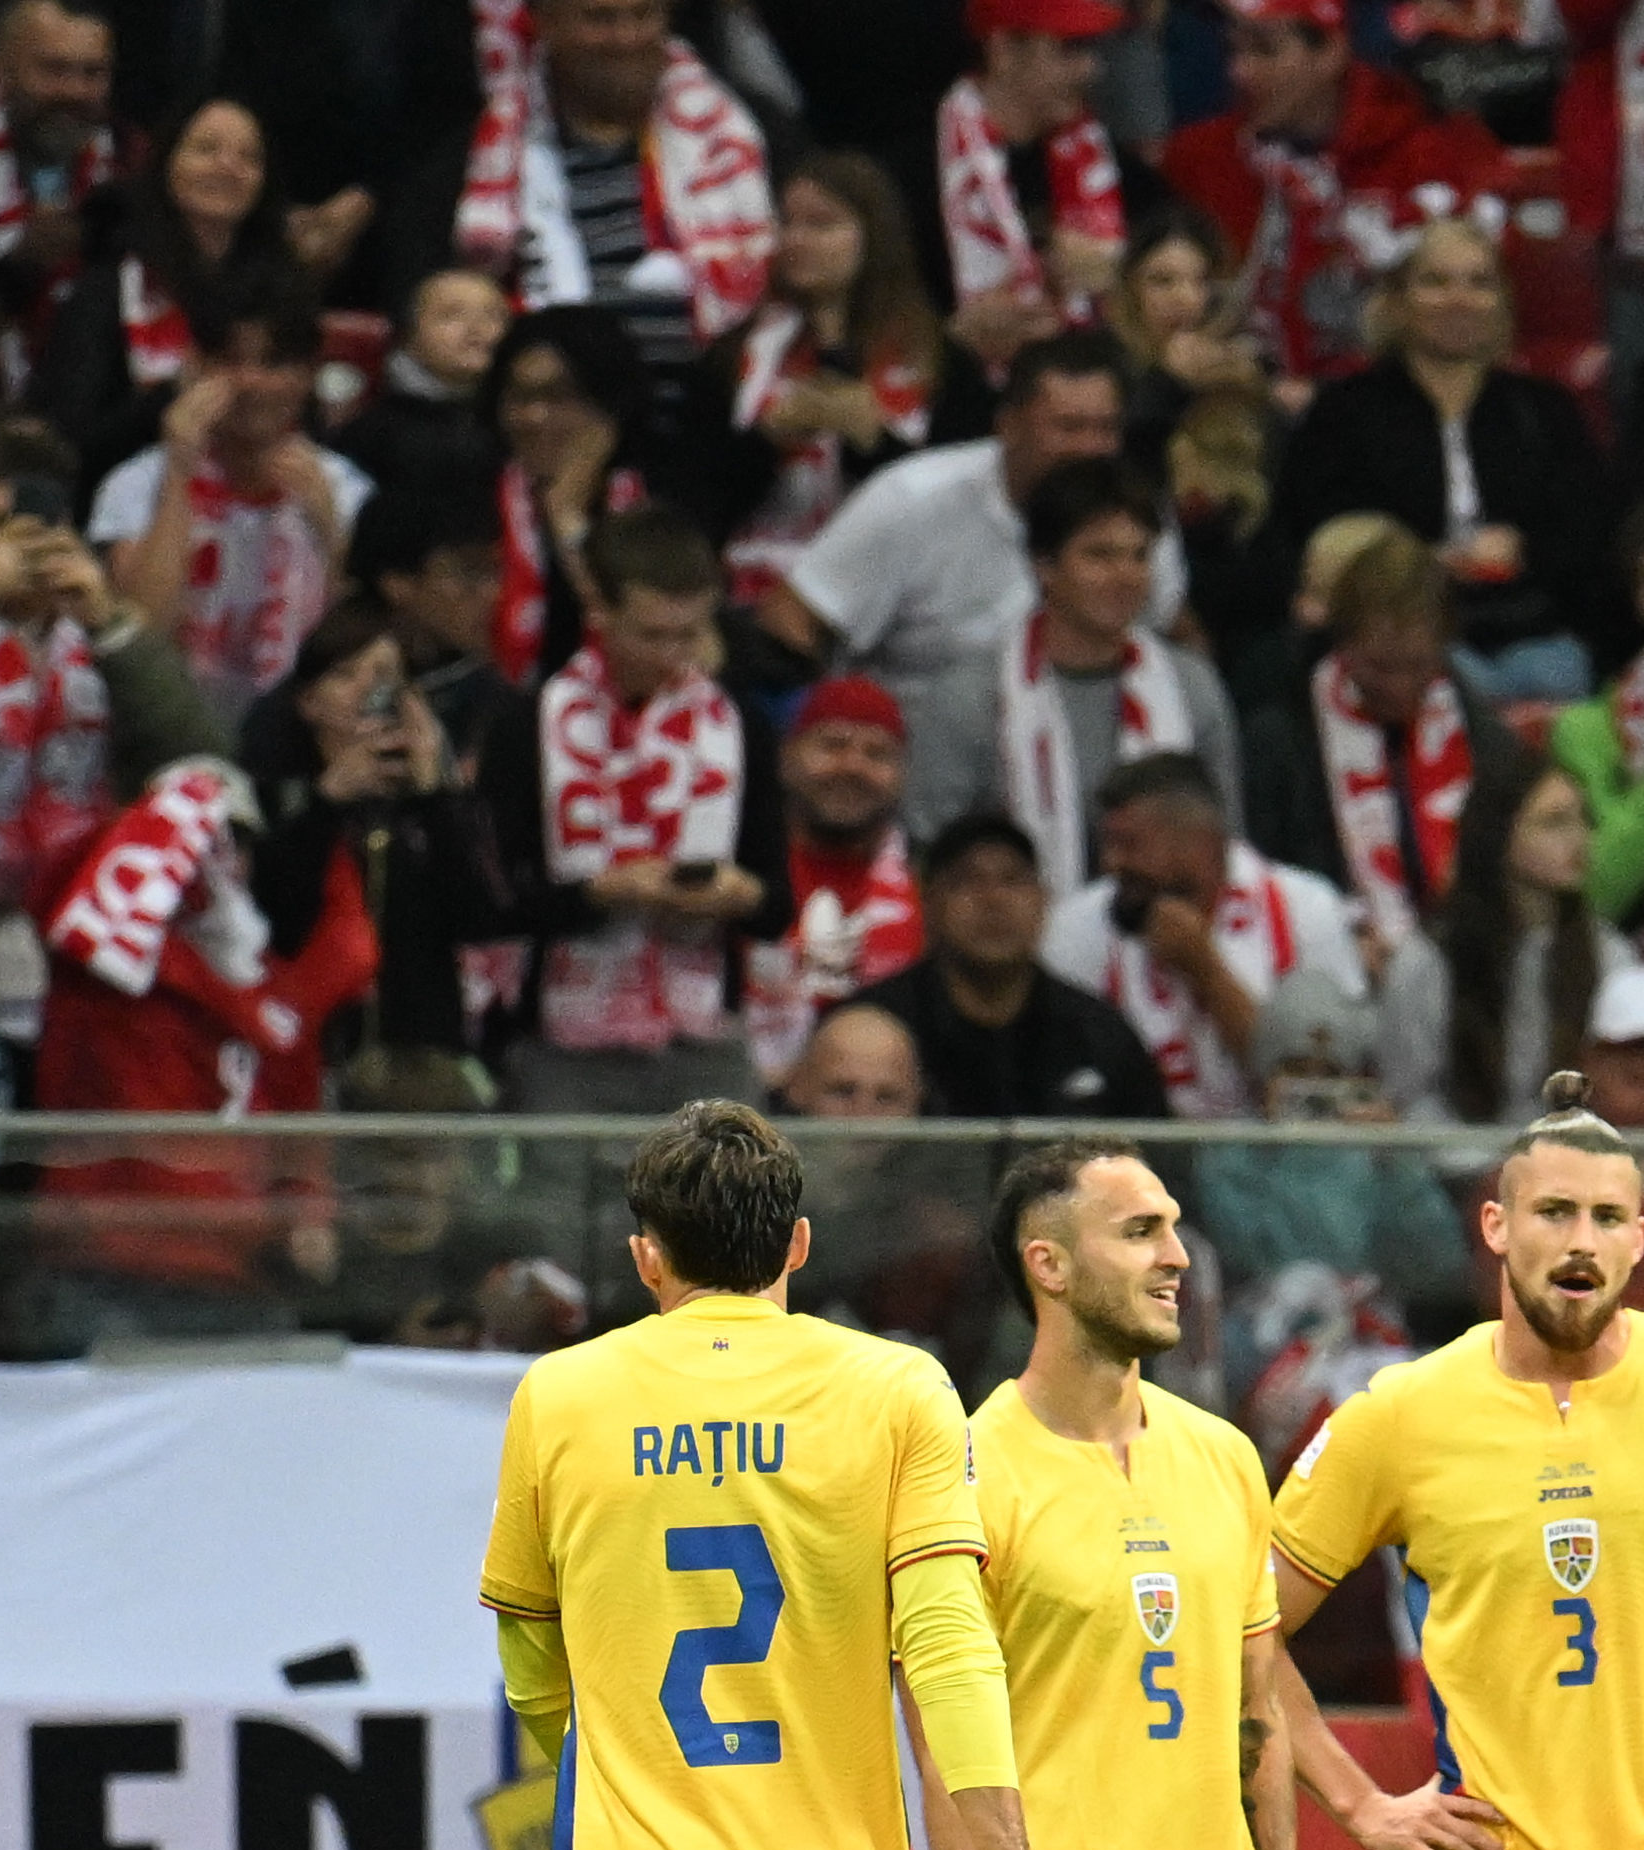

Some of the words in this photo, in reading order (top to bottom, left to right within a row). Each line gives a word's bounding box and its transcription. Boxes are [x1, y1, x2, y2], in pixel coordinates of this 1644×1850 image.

[633, 1421, 785, 1488] RAȚIU
[659, 1523, 786, 1768] 2
[1551, 1597, 1598, 1688] 3
[1140, 1651, 1184, 1741] 5
